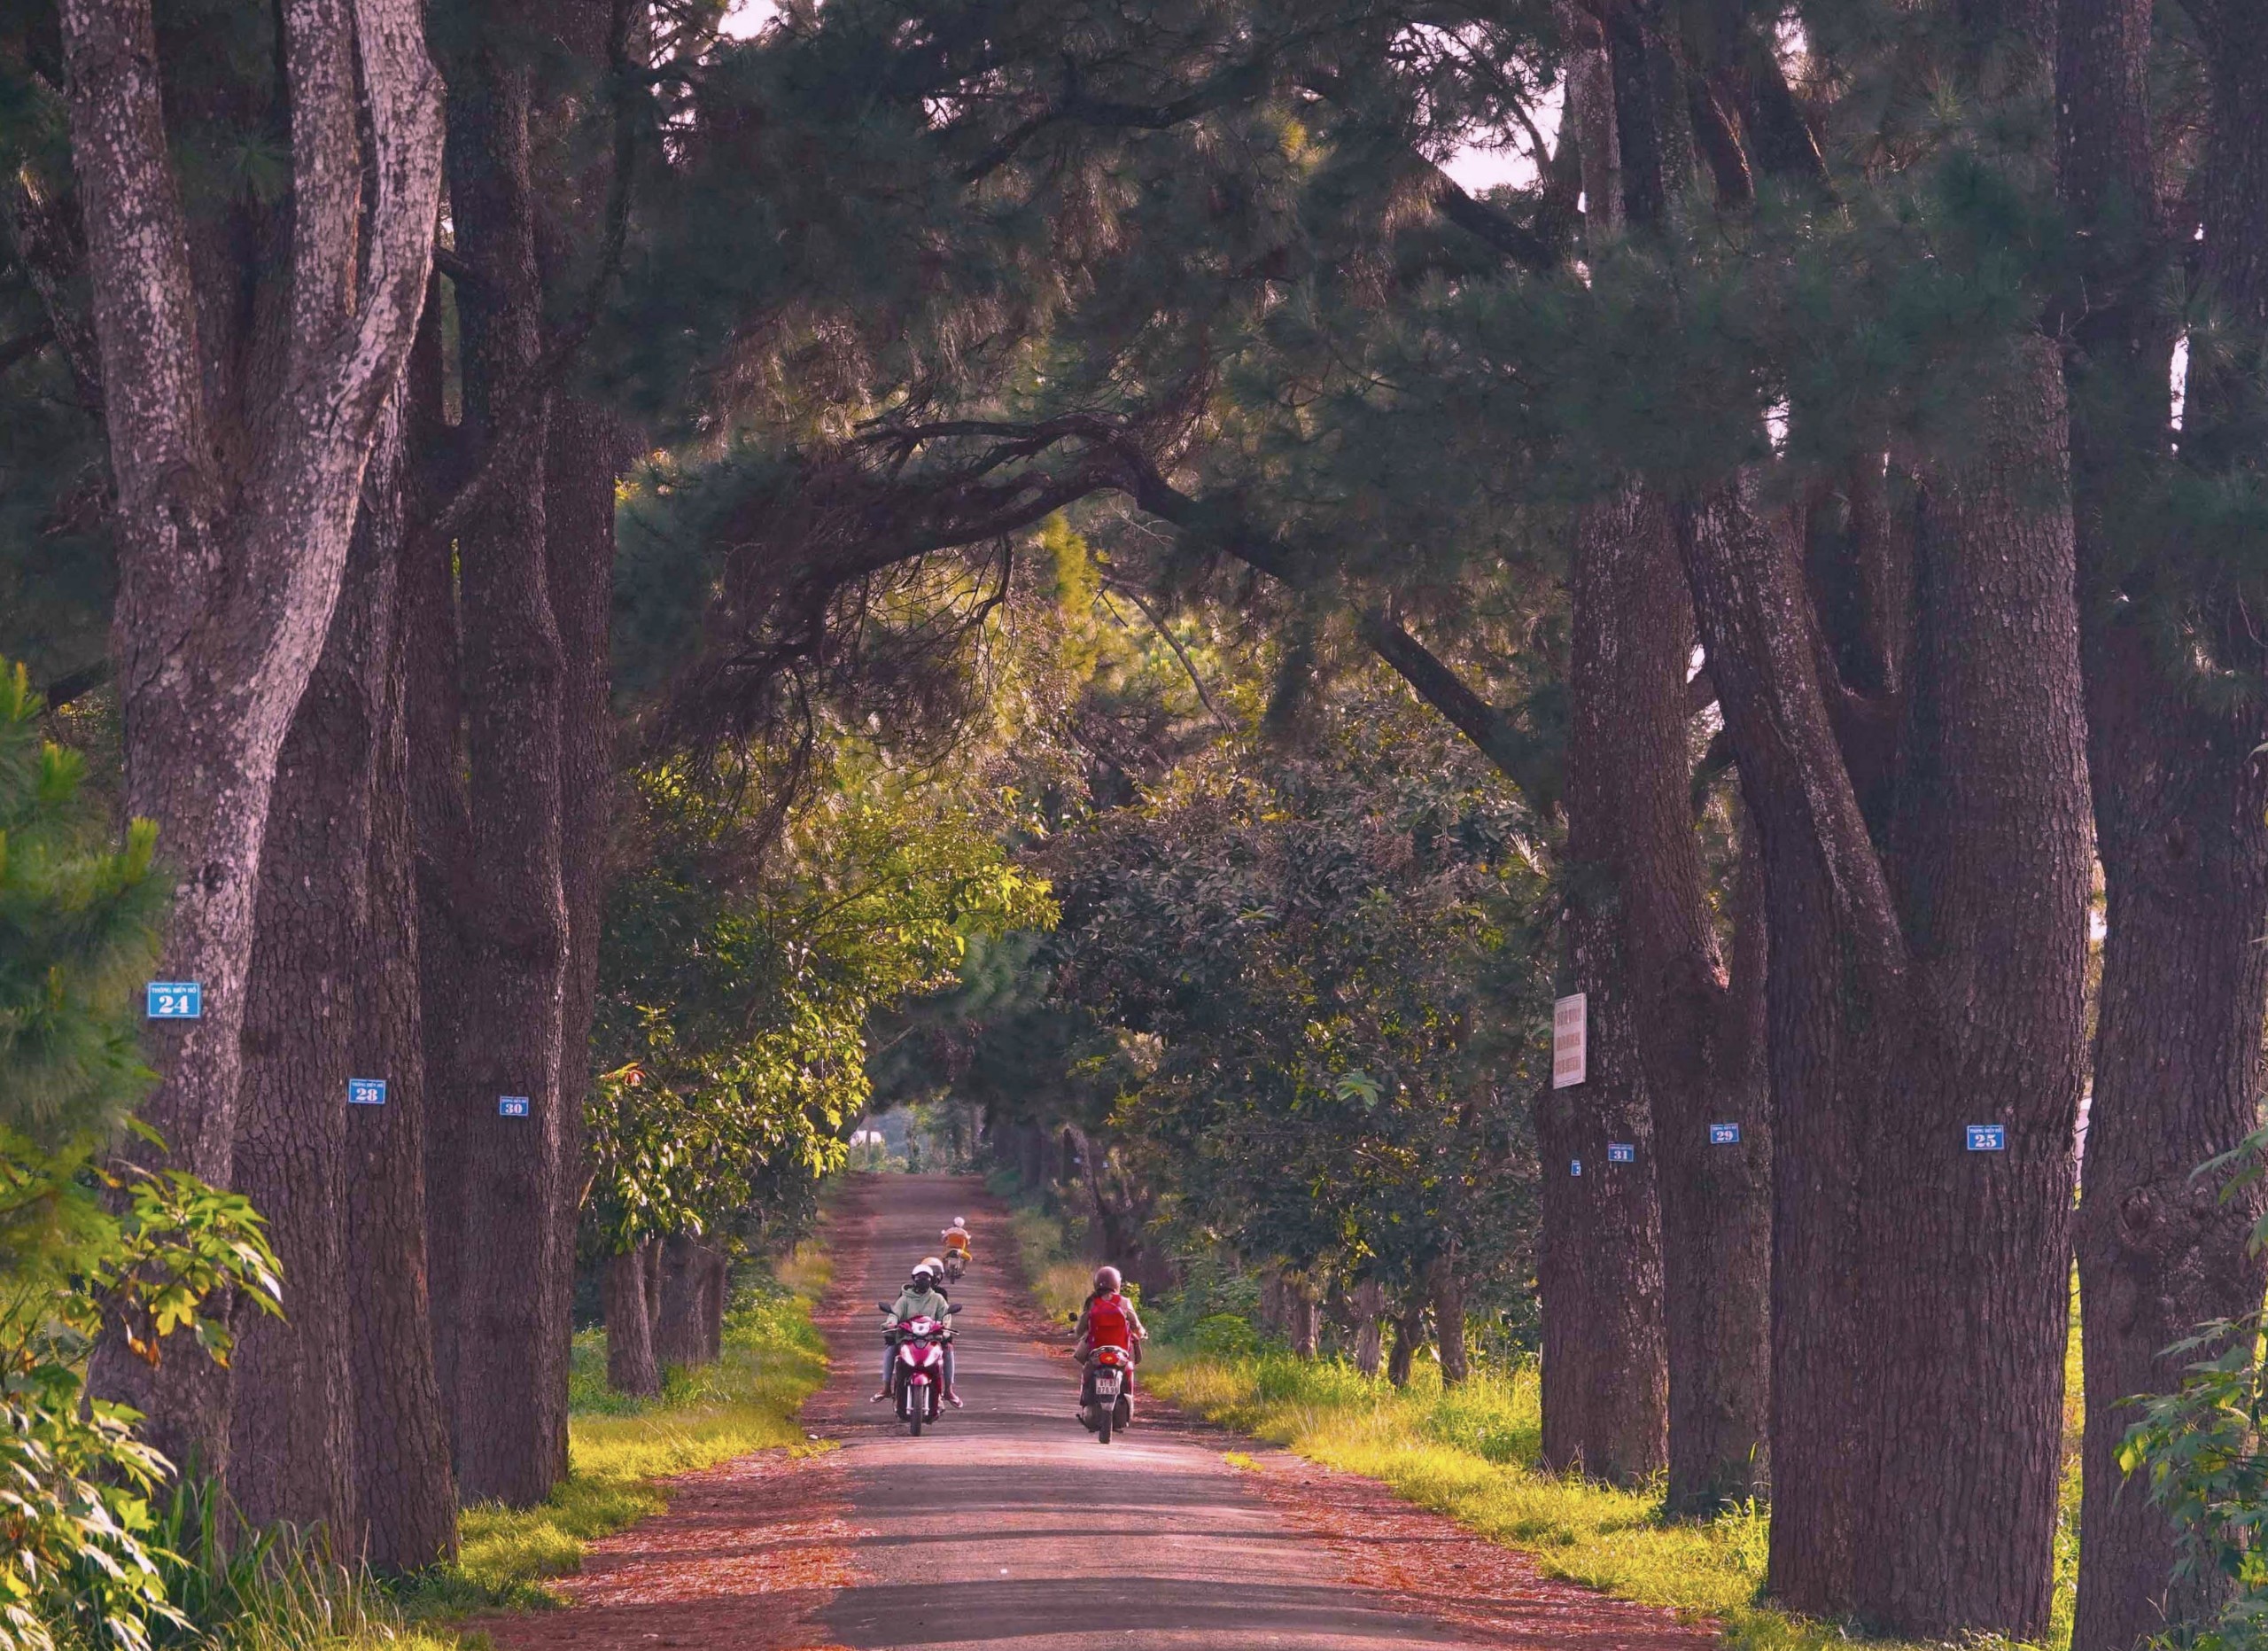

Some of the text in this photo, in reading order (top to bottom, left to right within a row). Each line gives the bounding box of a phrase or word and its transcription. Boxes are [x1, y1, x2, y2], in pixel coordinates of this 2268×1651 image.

[159, 995, 189, 1013] 24
[356, 1088, 377, 1101] 28
[505, 1103, 523, 1113] 30
[1716, 1130, 1734, 1141] 29
[1975, 1134, 1997, 1148] 25
[1614, 1150, 1627, 1159] 31
